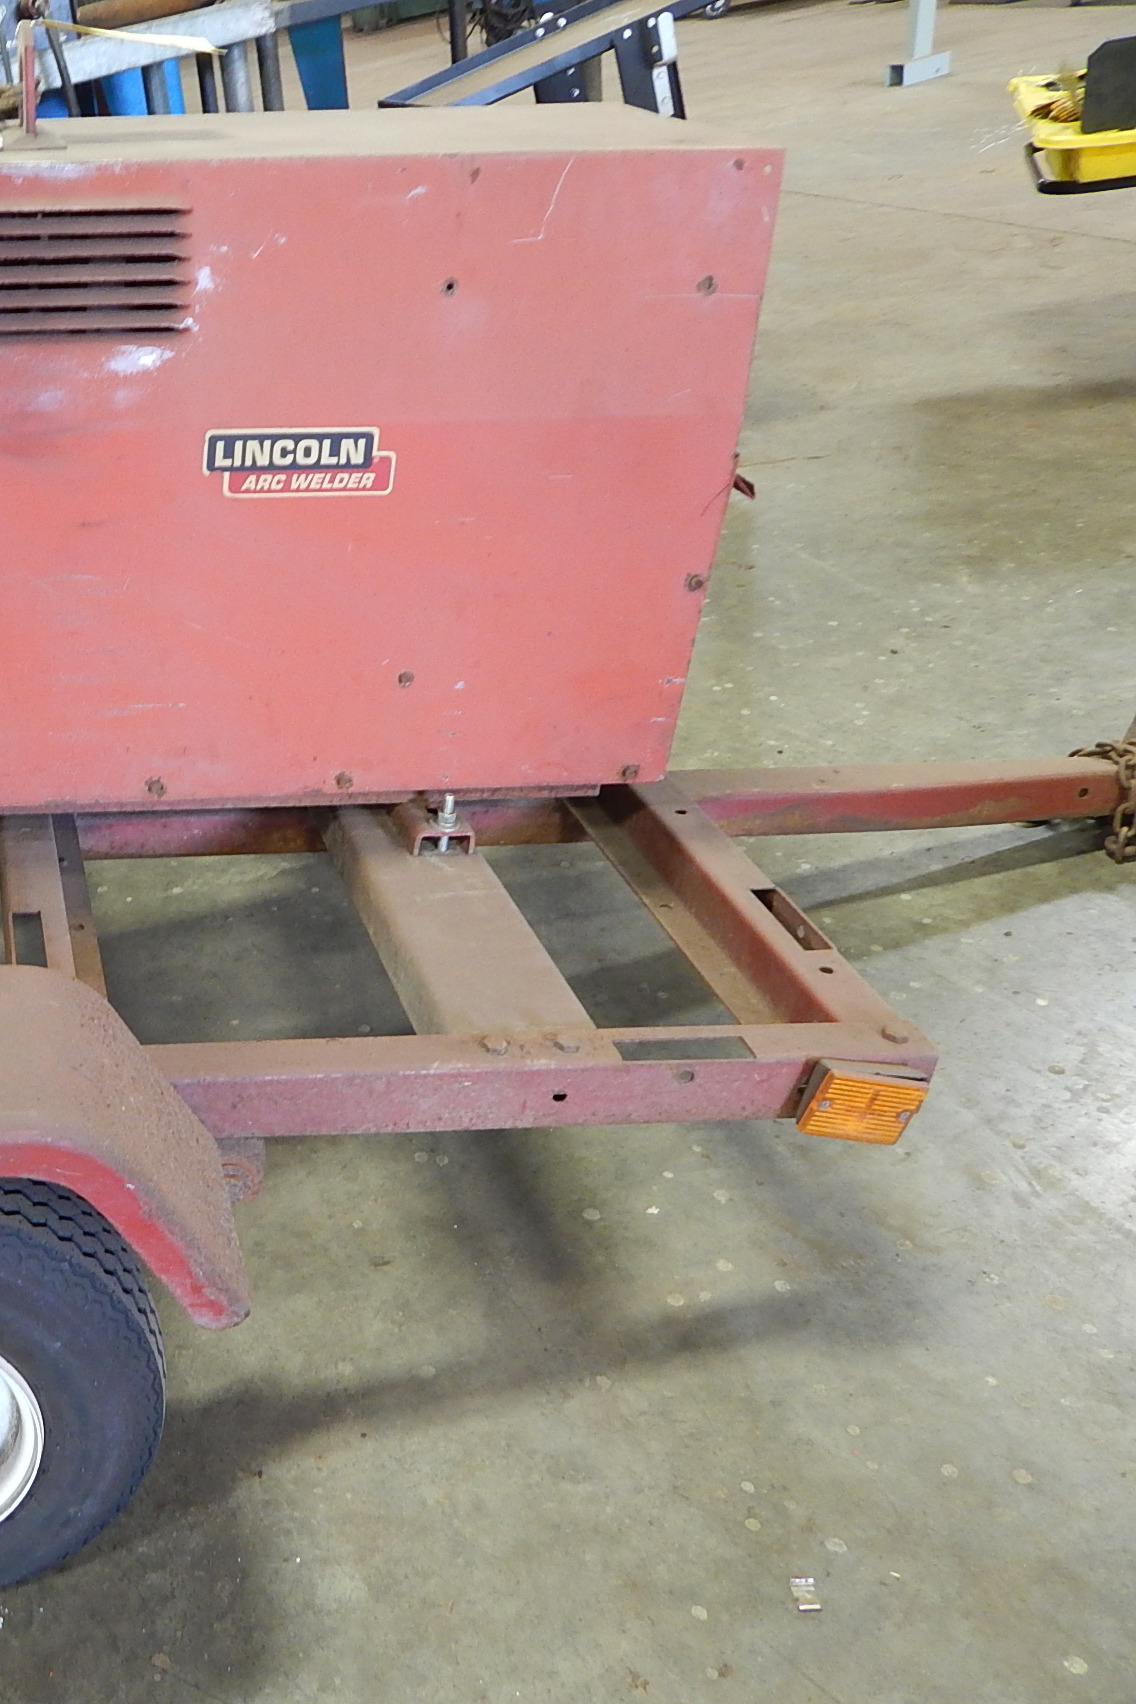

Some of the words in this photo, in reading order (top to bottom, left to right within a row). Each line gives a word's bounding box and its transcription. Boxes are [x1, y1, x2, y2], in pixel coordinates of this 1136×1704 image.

[214, 438, 366, 468] LINCOLN
[240, 474, 286, 491] ARC
[290, 473, 376, 490] WELDER
